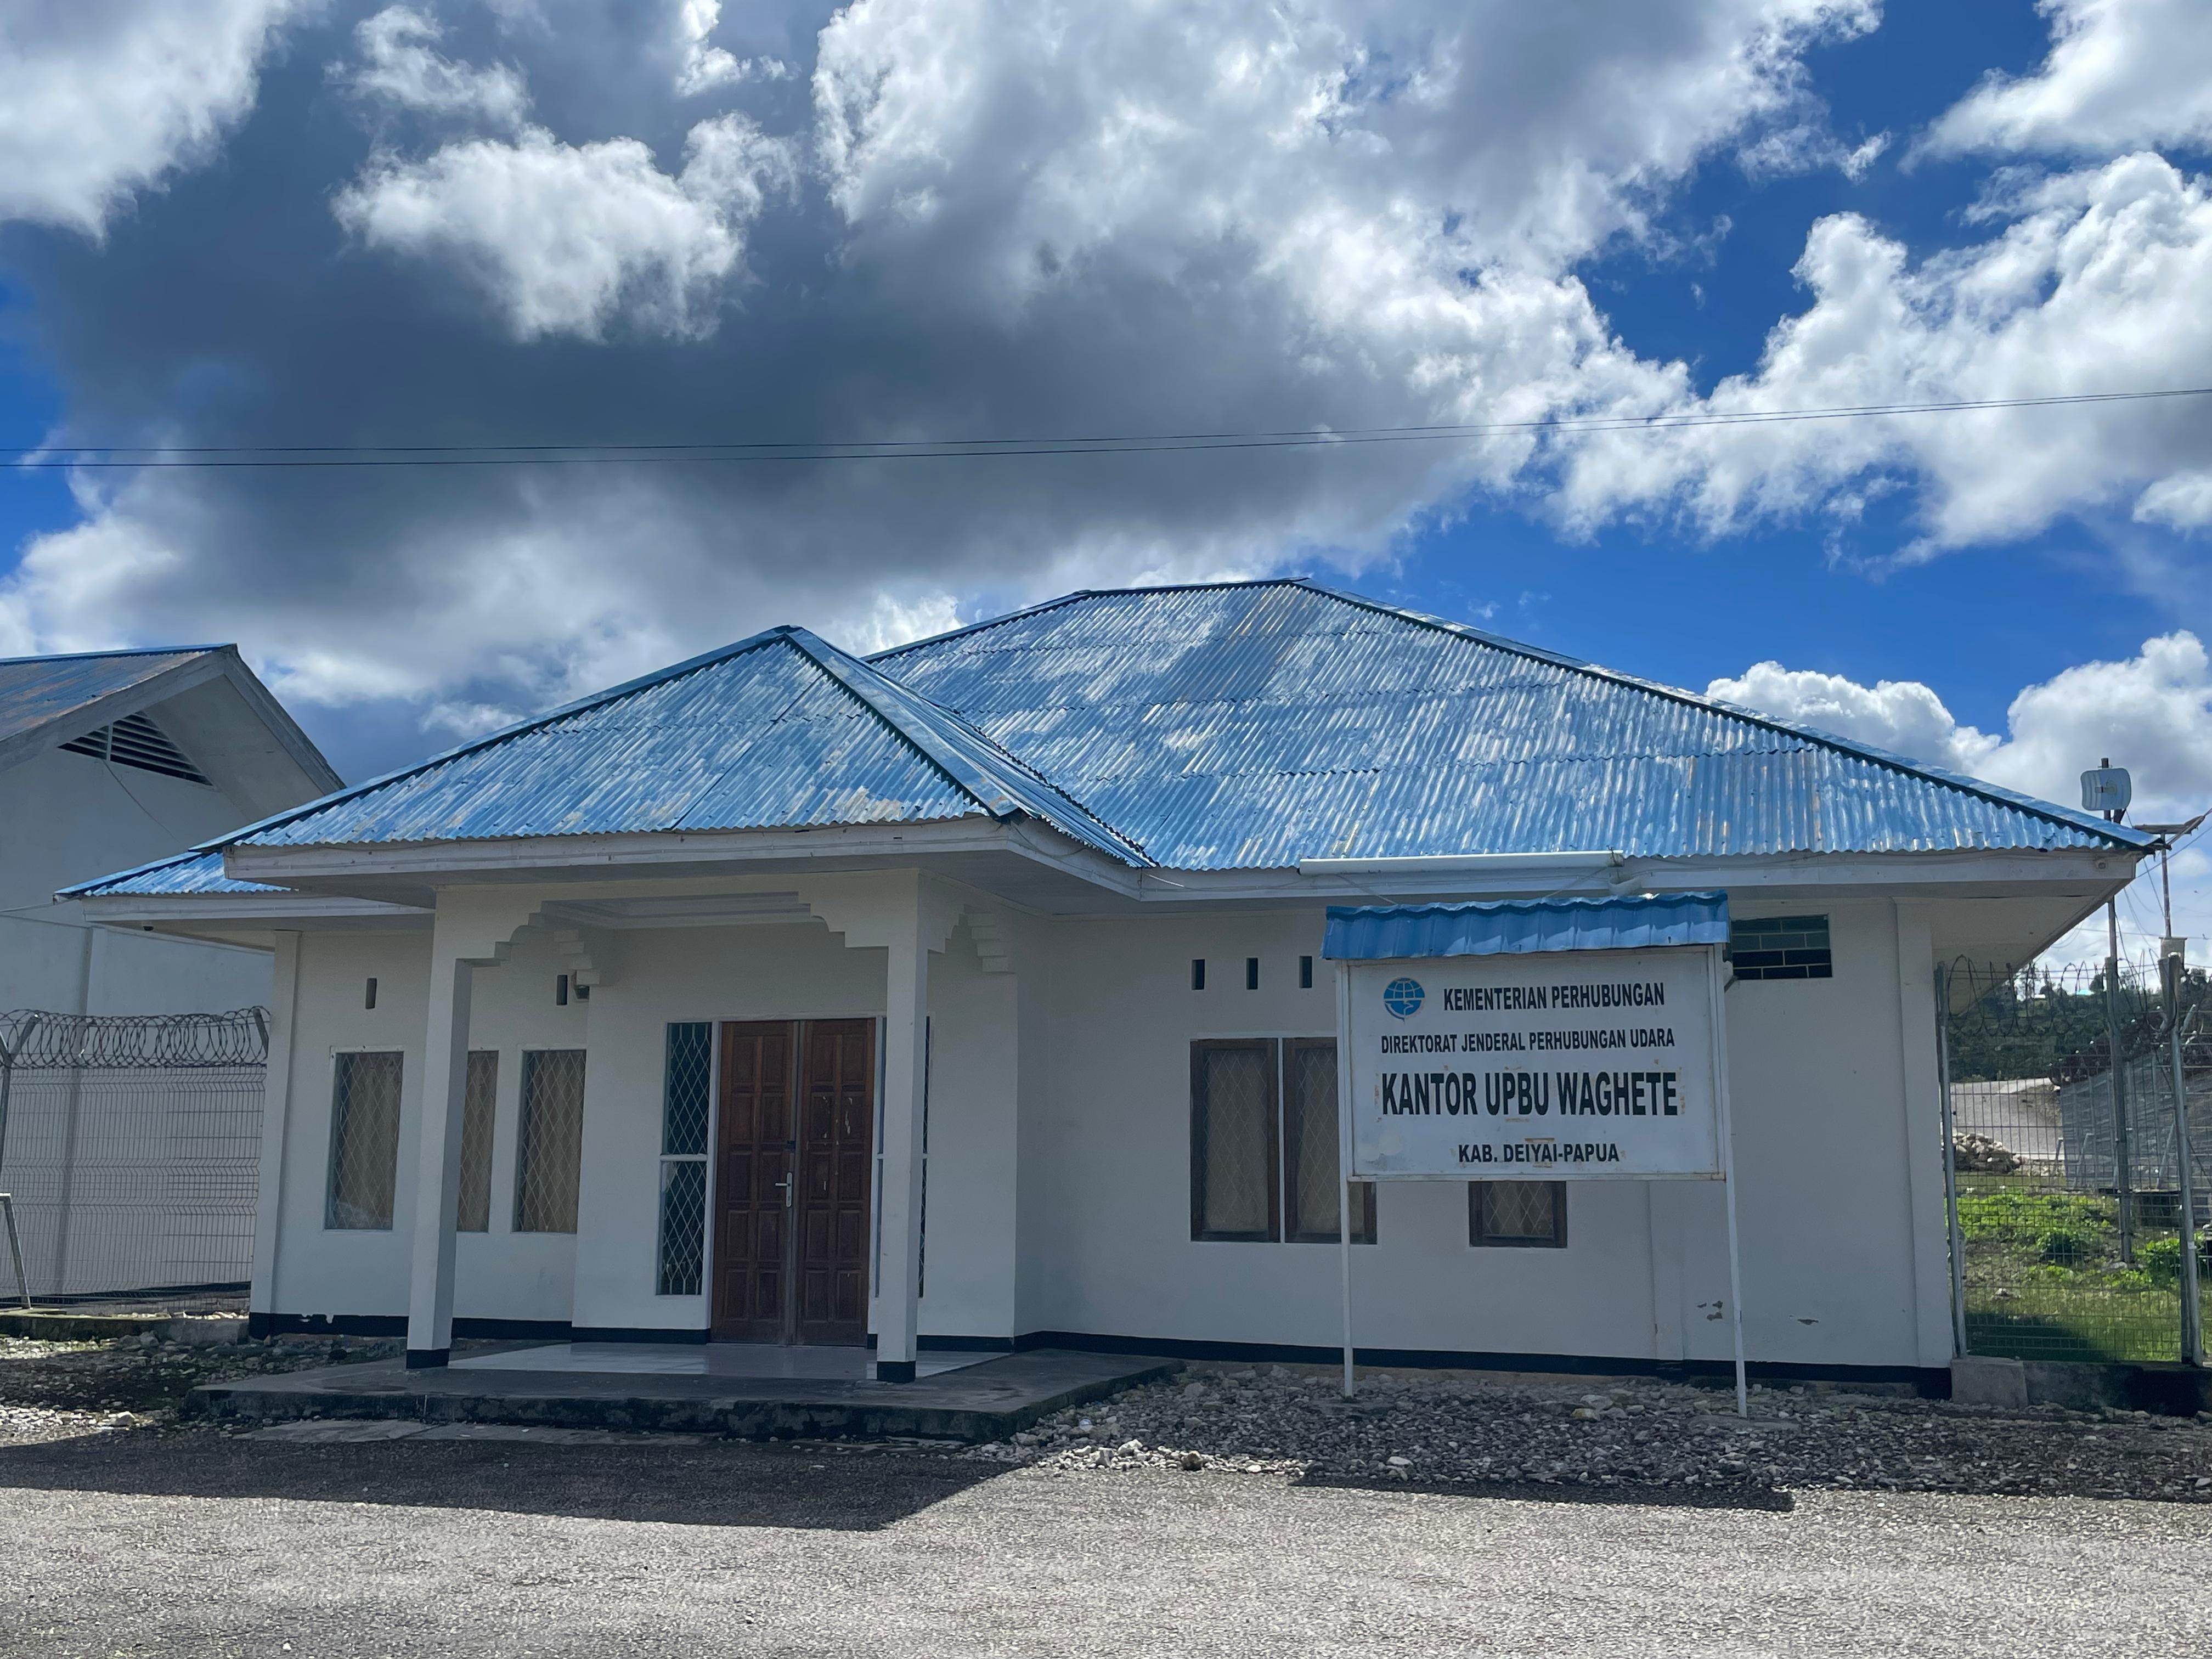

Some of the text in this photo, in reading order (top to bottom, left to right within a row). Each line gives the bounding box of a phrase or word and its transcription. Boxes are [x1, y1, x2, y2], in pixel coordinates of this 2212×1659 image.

[1443, 982, 1664, 1011] KEMENTERIAN PERHUBUNGAN
[1381, 1028, 1675, 1053] DIREKTORAT JENDERAL PERHUBUNGAN UDARA
[1382, 1071, 1678, 1115] KANTOR UPBU WAGHETE
[1458, 1143, 1620, 1163] KAB. DEIYAI-PAPUA
